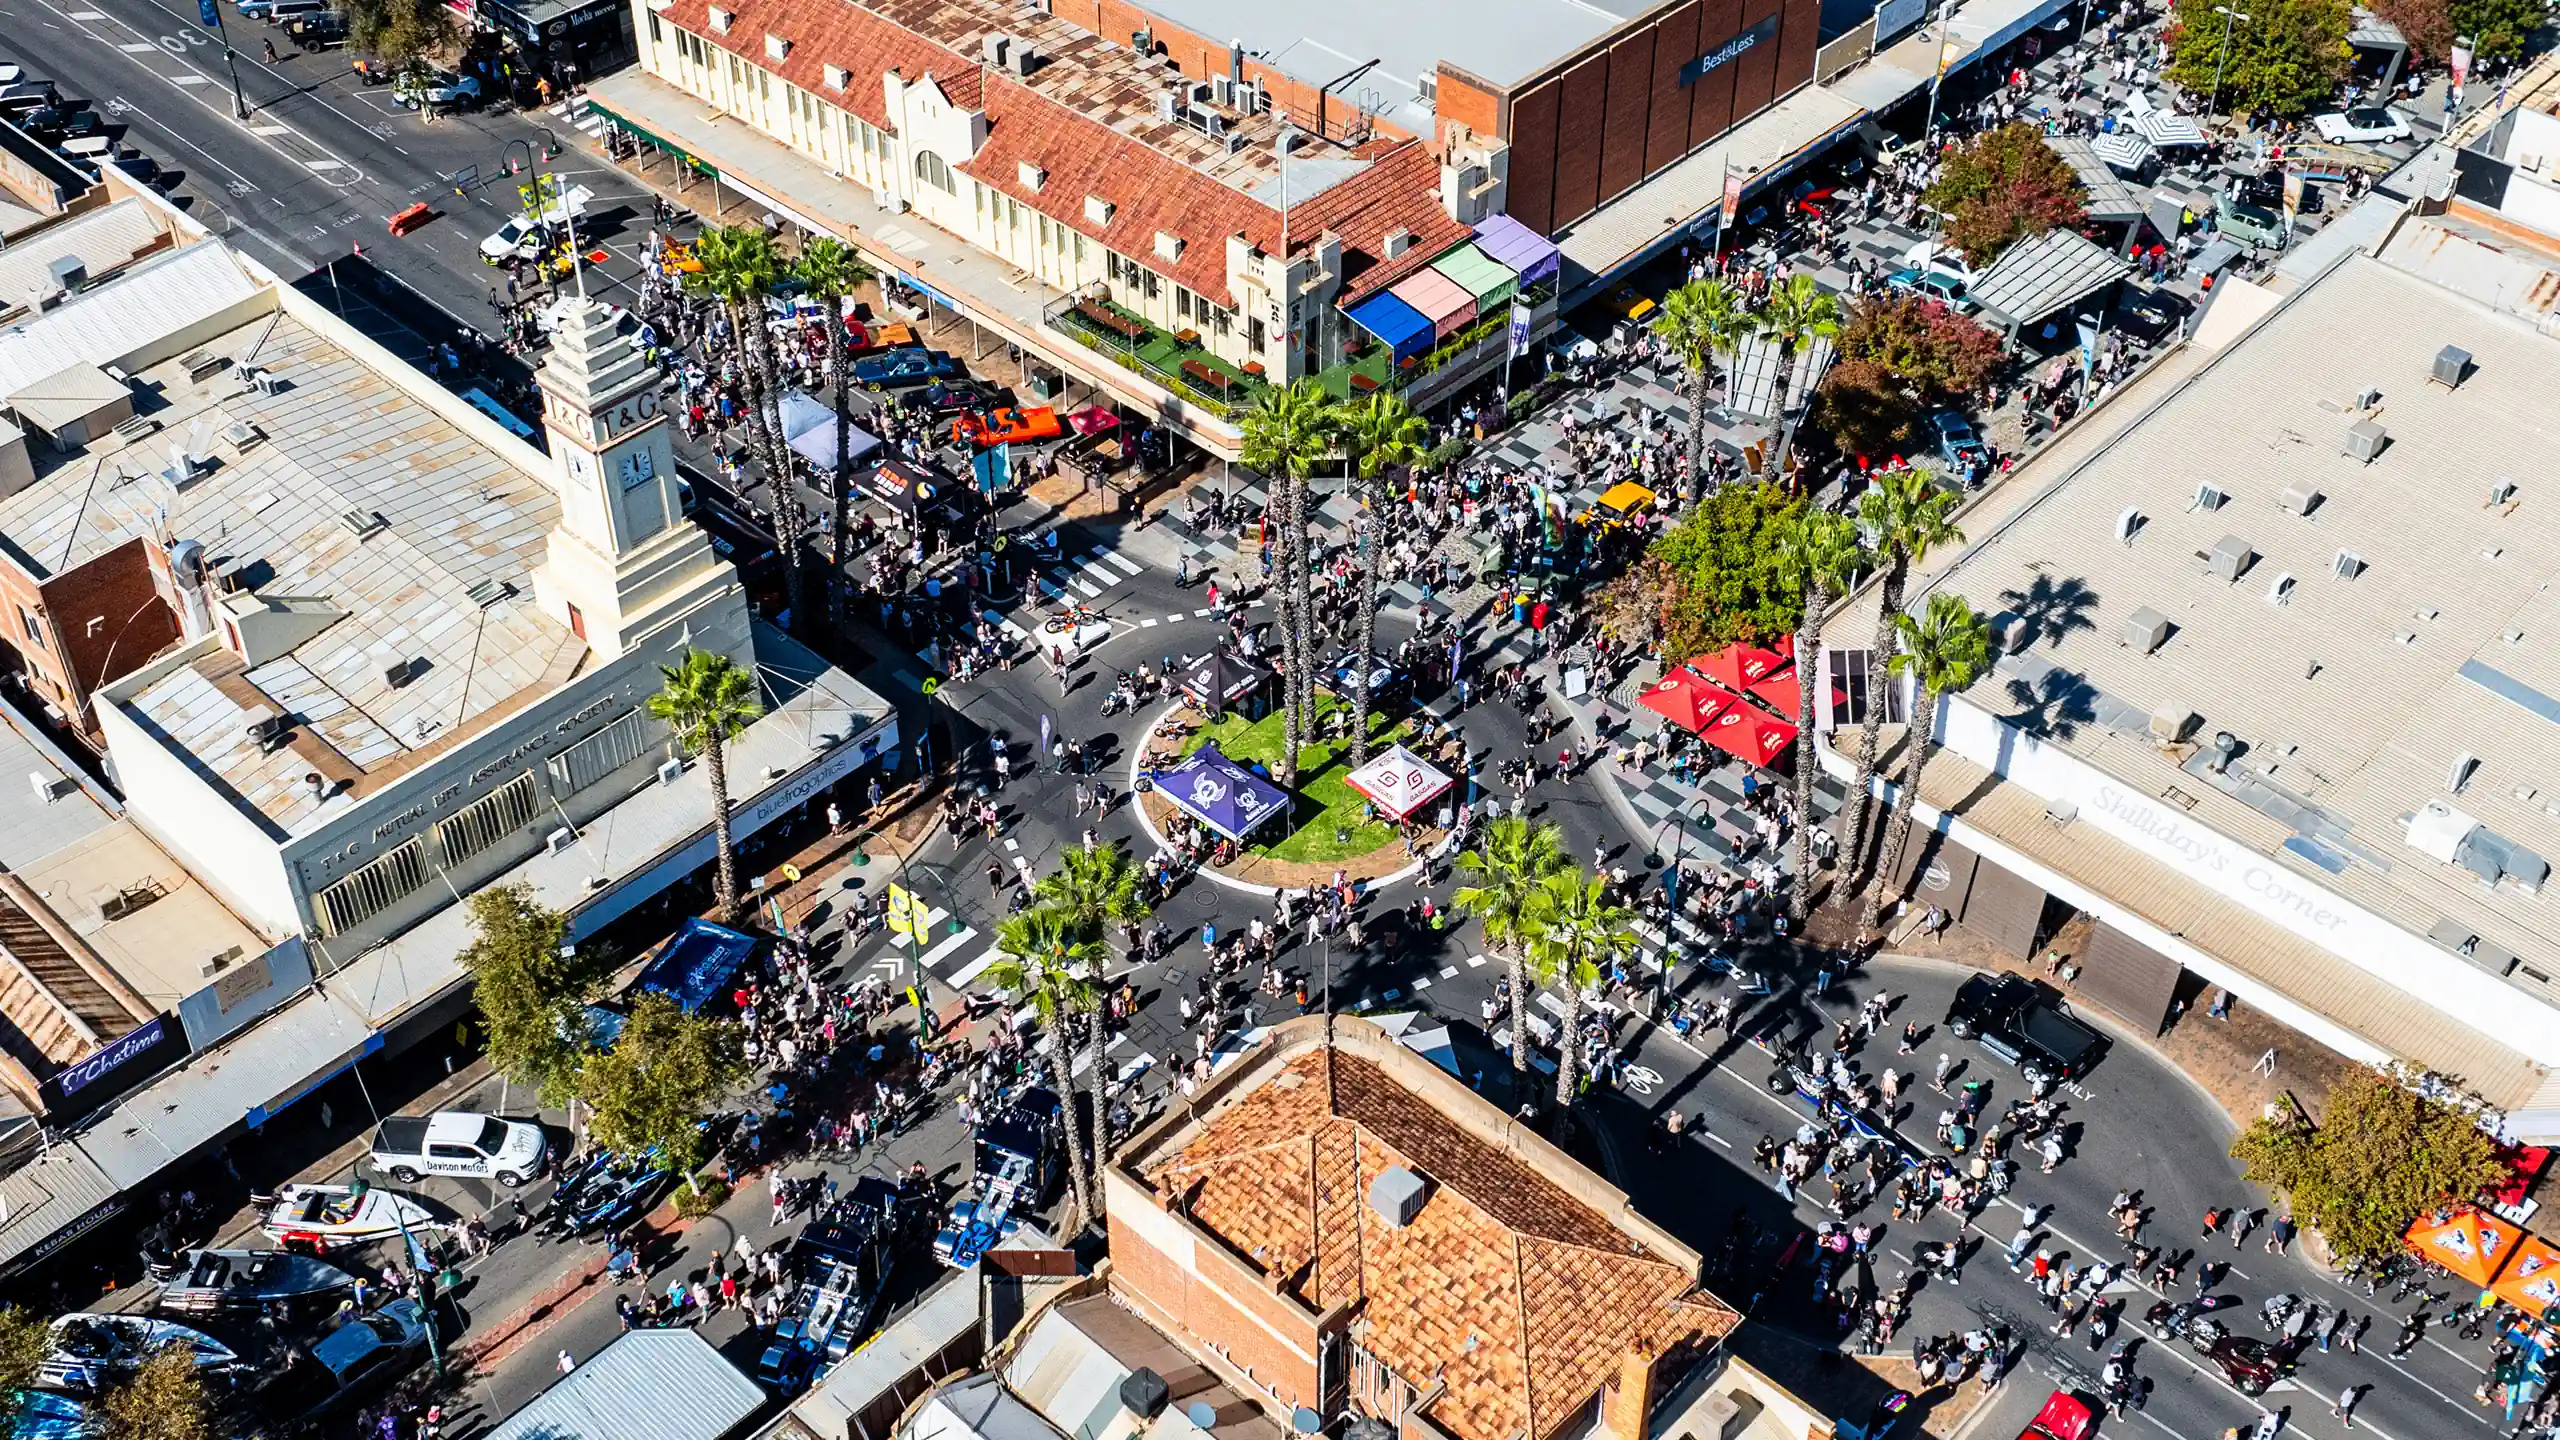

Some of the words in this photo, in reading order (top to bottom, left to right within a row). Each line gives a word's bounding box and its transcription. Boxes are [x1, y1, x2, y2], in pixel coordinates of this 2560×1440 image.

[1702, 34, 1755, 72] Best&Less
[372, 803, 428, 844] MUTUAL
[433, 782, 461, 808] LIFE
[469, 731, 551, 788] ASSURANCE
[556, 693, 616, 736] SOCIETY
[1365, 779, 1395, 801] GASGAS
[1409, 780, 1437, 802] GASGAS
[2092, 785, 2229, 871] Shilliday's
[2243, 867, 2347, 930] Corner
[85, 1030, 160, 1080] Chatime
[427, 1160, 459, 1171] Davison
[460, 1163, 489, 1173] Motors
[35, 1229, 73, 1256] KEBAB
[76, 1202, 116, 1230] HOUSE
